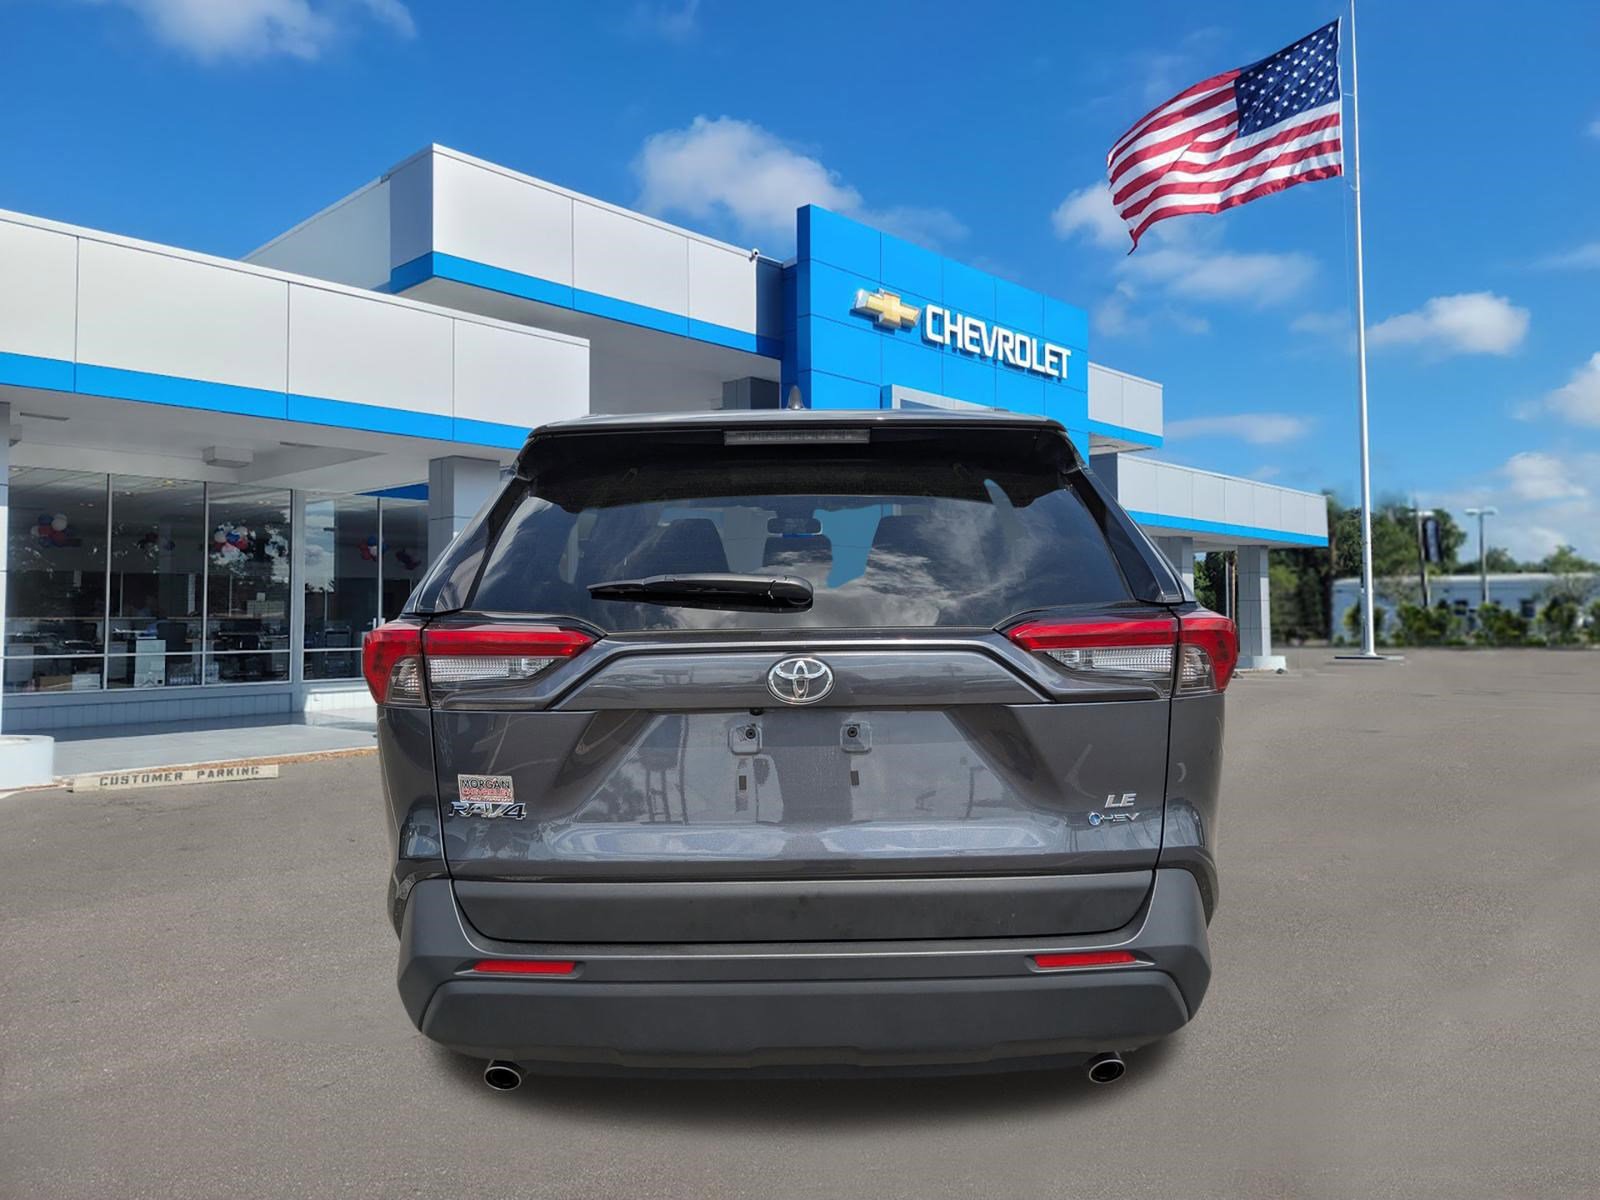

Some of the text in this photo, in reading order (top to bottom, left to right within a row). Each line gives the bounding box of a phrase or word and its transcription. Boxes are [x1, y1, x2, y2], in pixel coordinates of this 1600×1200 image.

[924, 303, 1072, 379] CHEVROLET
[99, 766, 260, 787] CUSTOMER PARKING
[461, 779, 511, 790] MORGAN
[448, 801, 527, 820] RAV4
[1104, 793, 1137, 809] LE
